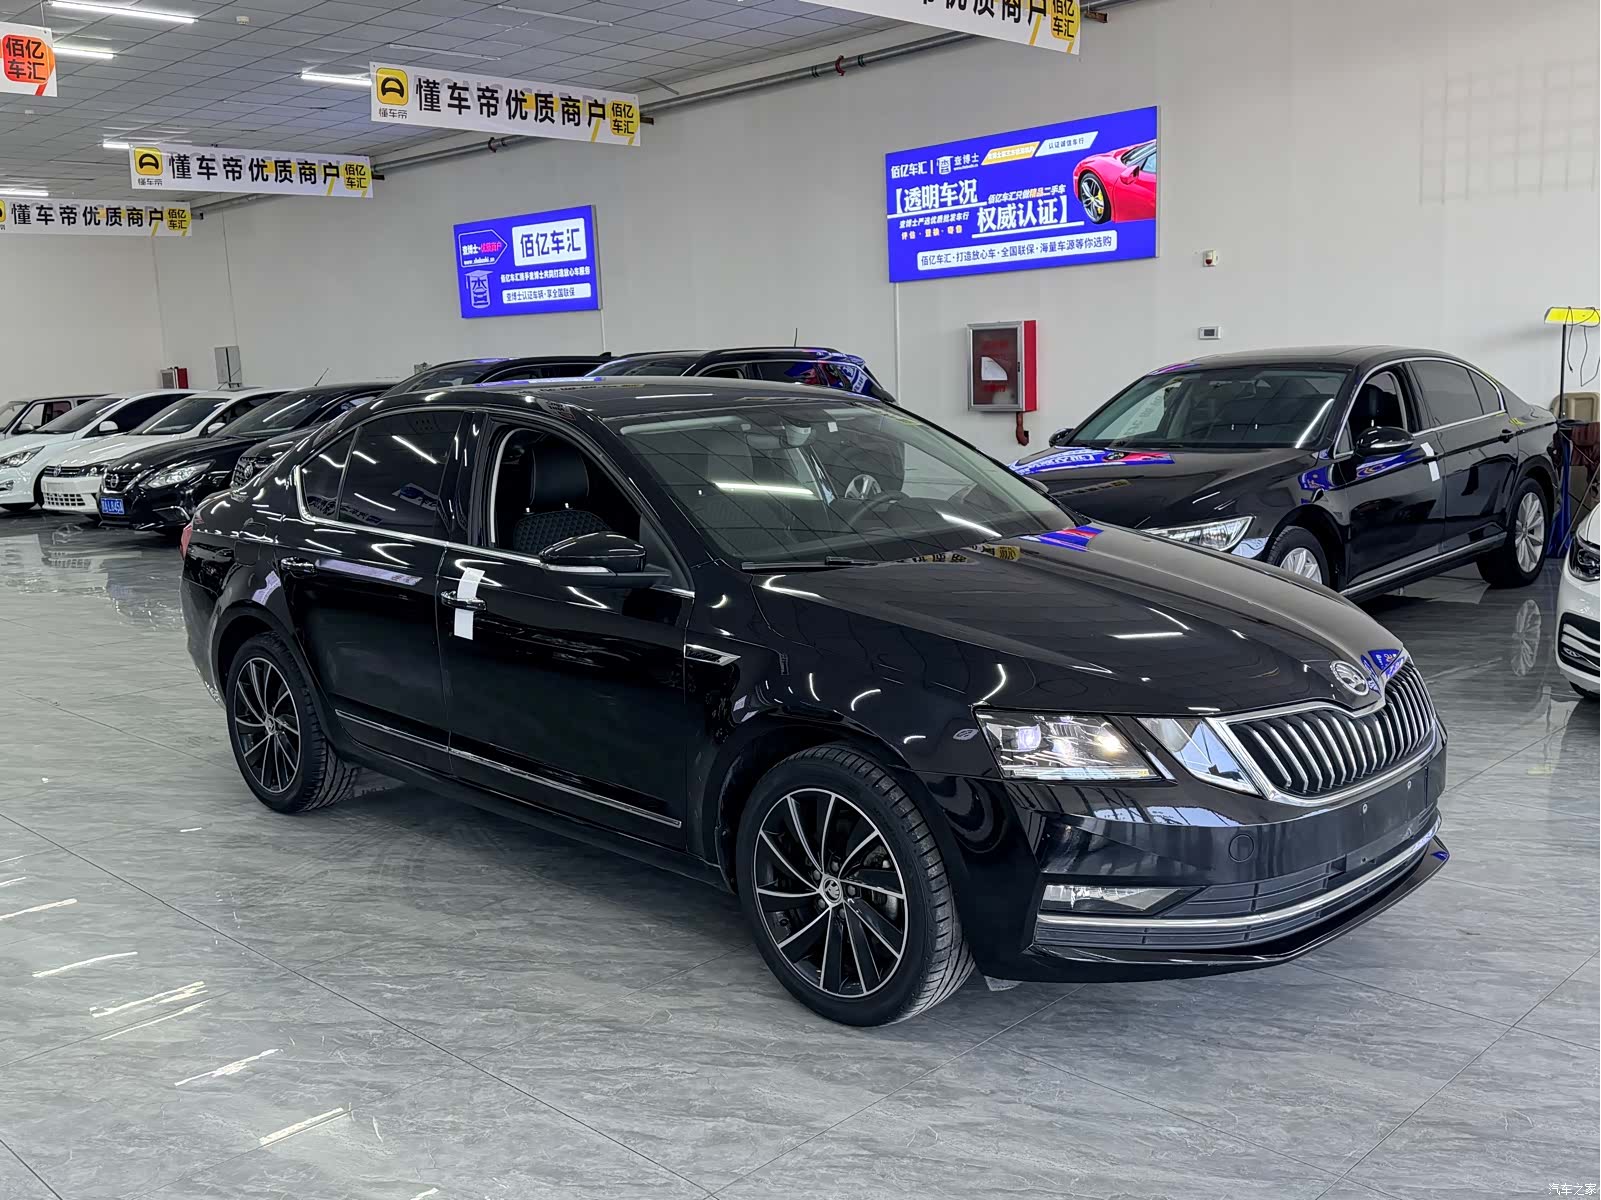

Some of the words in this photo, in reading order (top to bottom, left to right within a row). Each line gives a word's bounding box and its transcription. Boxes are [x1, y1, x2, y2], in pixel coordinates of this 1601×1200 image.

[1052, 16, 1075, 38] 车汇
[6, 37, 44, 59] 佰亿
[7, 59, 46, 80] 车汇
[415, 77, 606, 128] 懂车帝优质商户
[611, 102, 634, 119] 佰亿
[378, 107, 408, 119] 懂车帝
[612, 119, 635, 135] 车汇
[168, 153, 340, 185] 懂车帝优质商户
[344, 163, 366, 176] 佰亿
[891, 161, 928, 179] 佰亿车汇
[345, 176, 368, 189] 车汇
[988, 184, 1067, 204] 佰亿车汇只做精品二手车
[11, 203, 164, 228] 懂车帝优质商户
[168, 208, 187, 219] 佰亿
[168, 219, 188, 230] 车汇
[520, 228, 582, 258] 佰亿车汇
